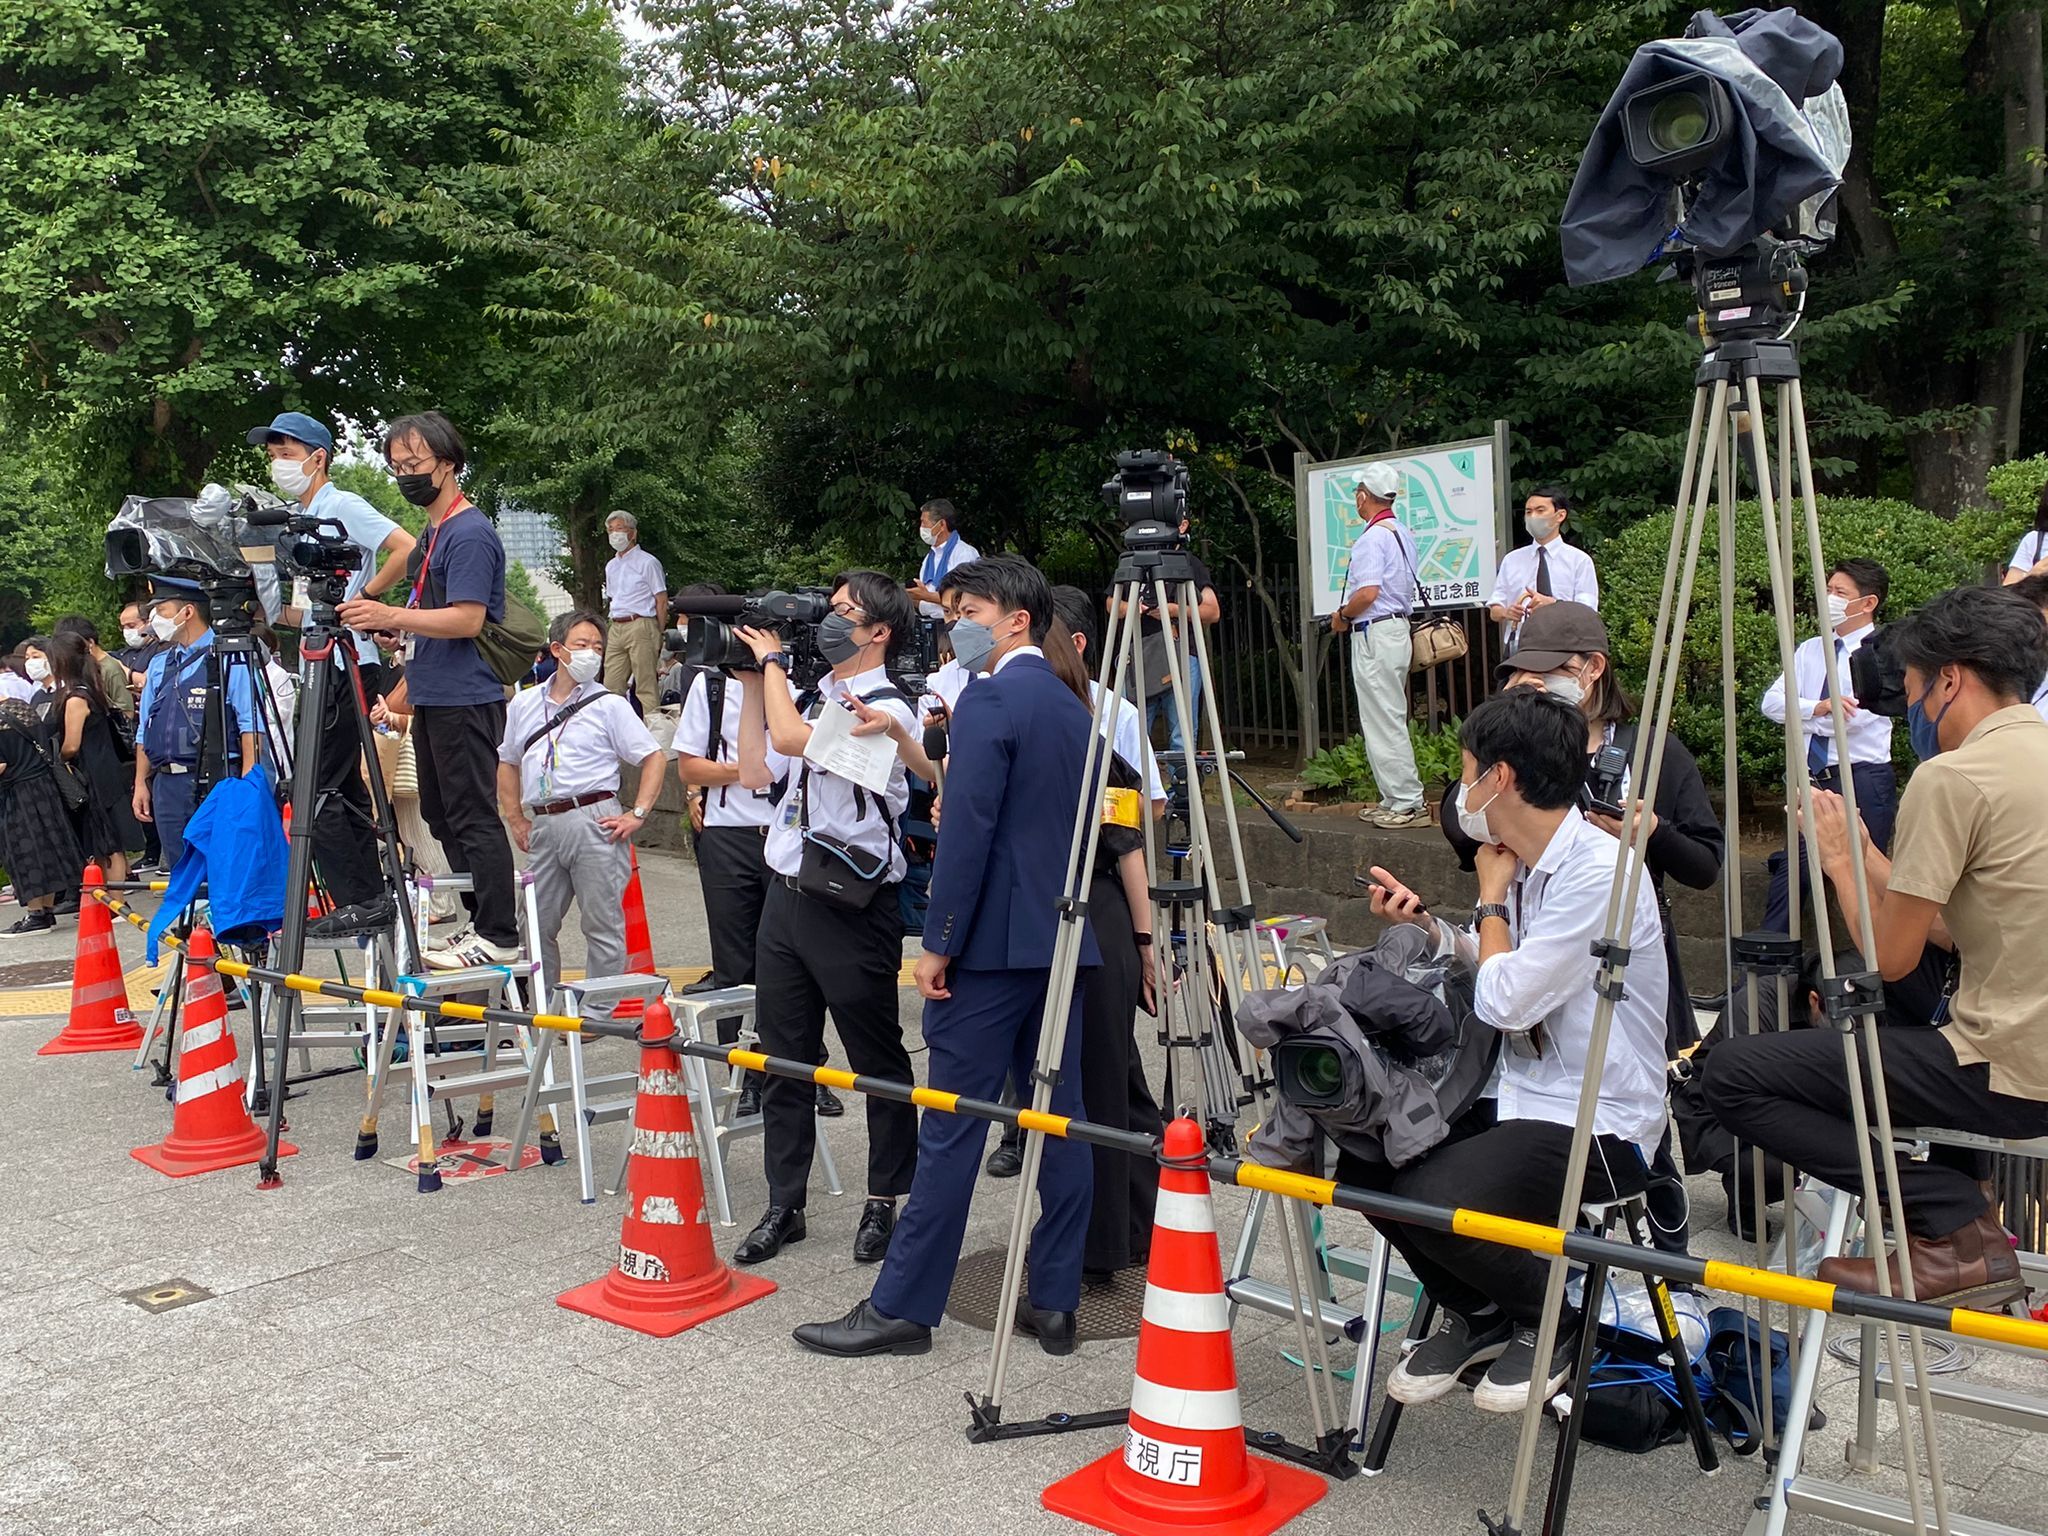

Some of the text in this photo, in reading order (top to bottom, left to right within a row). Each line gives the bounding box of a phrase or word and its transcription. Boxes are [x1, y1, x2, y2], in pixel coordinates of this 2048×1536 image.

[1411, 581, 1480, 602] 政記念館
[618, 1245, 663, 1279] 視庁
